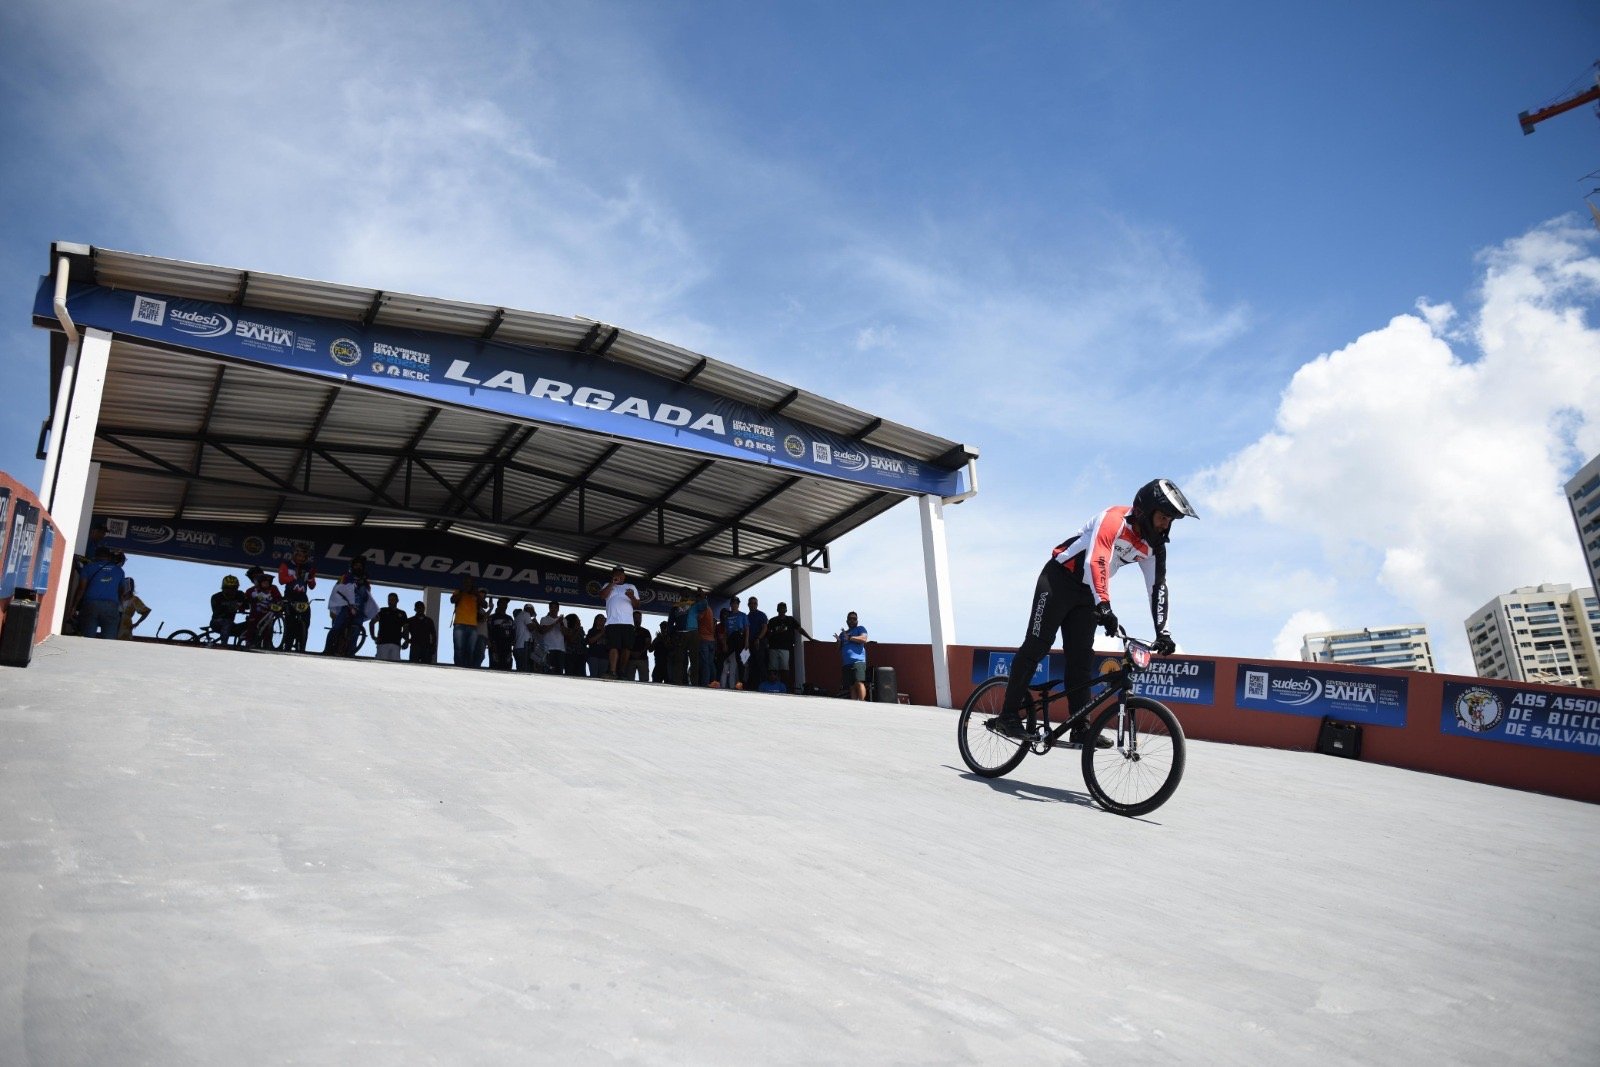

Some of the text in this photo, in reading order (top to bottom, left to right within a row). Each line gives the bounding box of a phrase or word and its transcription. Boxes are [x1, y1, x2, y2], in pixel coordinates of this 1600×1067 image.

[170, 309, 220, 326] sudesb
[235, 323, 292, 347] BAHIA
[374, 348, 430, 364] BMX RACE
[444, 359, 726, 435] LARGADA
[833, 450, 861, 462] sudesb
[324, 543, 539, 585] LARGADA
[1146, 685, 1200, 699] CICLISMO
[1272, 678, 1311, 691] sudesb
[1325, 684, 1376, 704] BAHIA
[1512, 693, 1547, 708] ABS
[1508, 708, 1533, 722] DE
[1548, 712, 1600, 730] BICIC
[1505, 722, 1527, 737] DE
